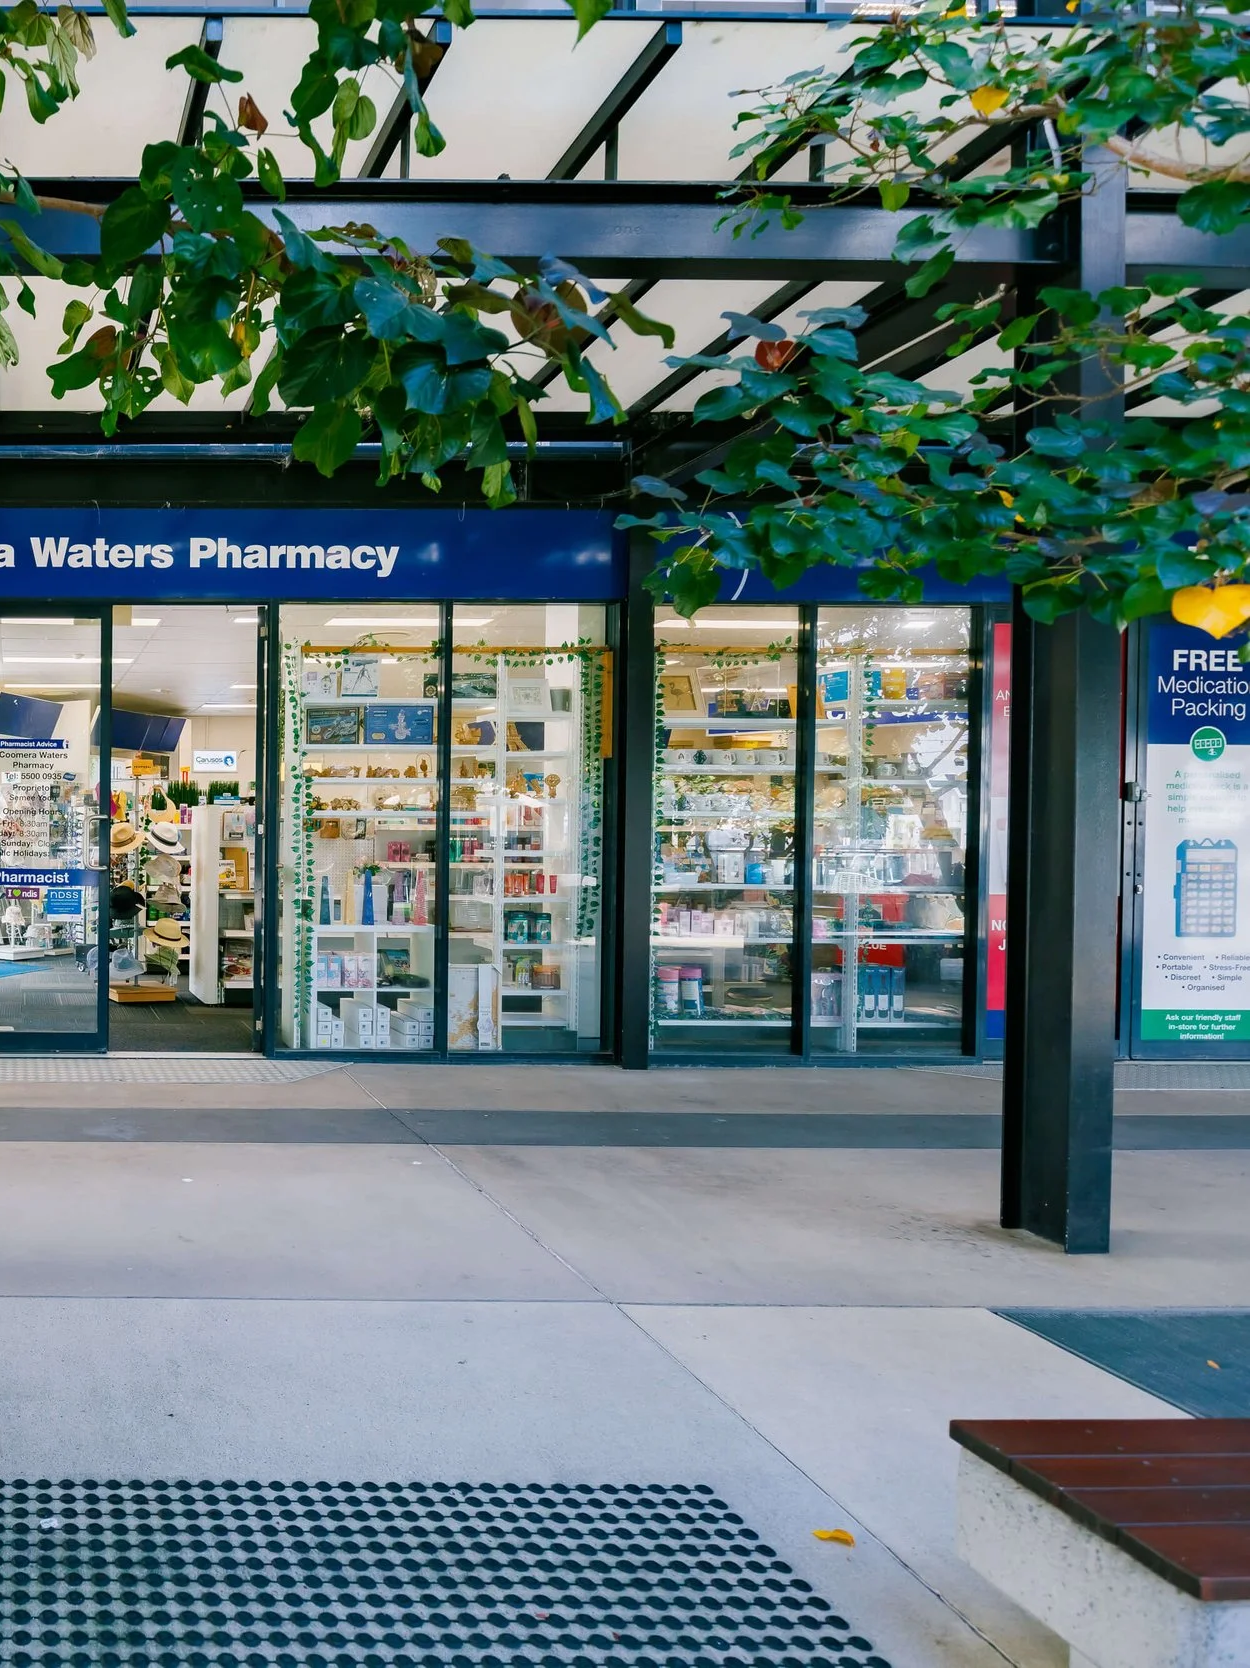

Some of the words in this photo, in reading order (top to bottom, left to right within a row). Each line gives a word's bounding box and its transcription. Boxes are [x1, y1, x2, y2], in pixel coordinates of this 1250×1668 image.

[29, 536, 174, 569] Waters
[189, 537, 400, 578] Pharmacy
[1173, 649, 1243, 671] FREE
[1158, 675, 1250, 694] Medicatio
[1171, 698, 1246, 721] Packing
[0, 751, 37, 759] Coomera
[39, 751, 68, 759] Waters
[12, 761, 54, 770] Pharmacy
[5, 772, 19, 780] Tel:
[21, 772, 40, 780] 5500
[42, 772, 62, 780] 0935
[2, 807, 37, 816] Opening
[1167, 805, 1187, 813] help
[19, 829, 48, 837] 8:30am
[1, 839, 34, 848] Sunday:
[13, 848, 50, 858] Holidays:
[21, 890, 38, 898] ndis
[1163, 953, 1205, 961] Convenient
[1217, 974, 1243, 982] Simple
[1187, 984, 1225, 992] Organised
[1195, 1014, 1223, 1022] friendly
